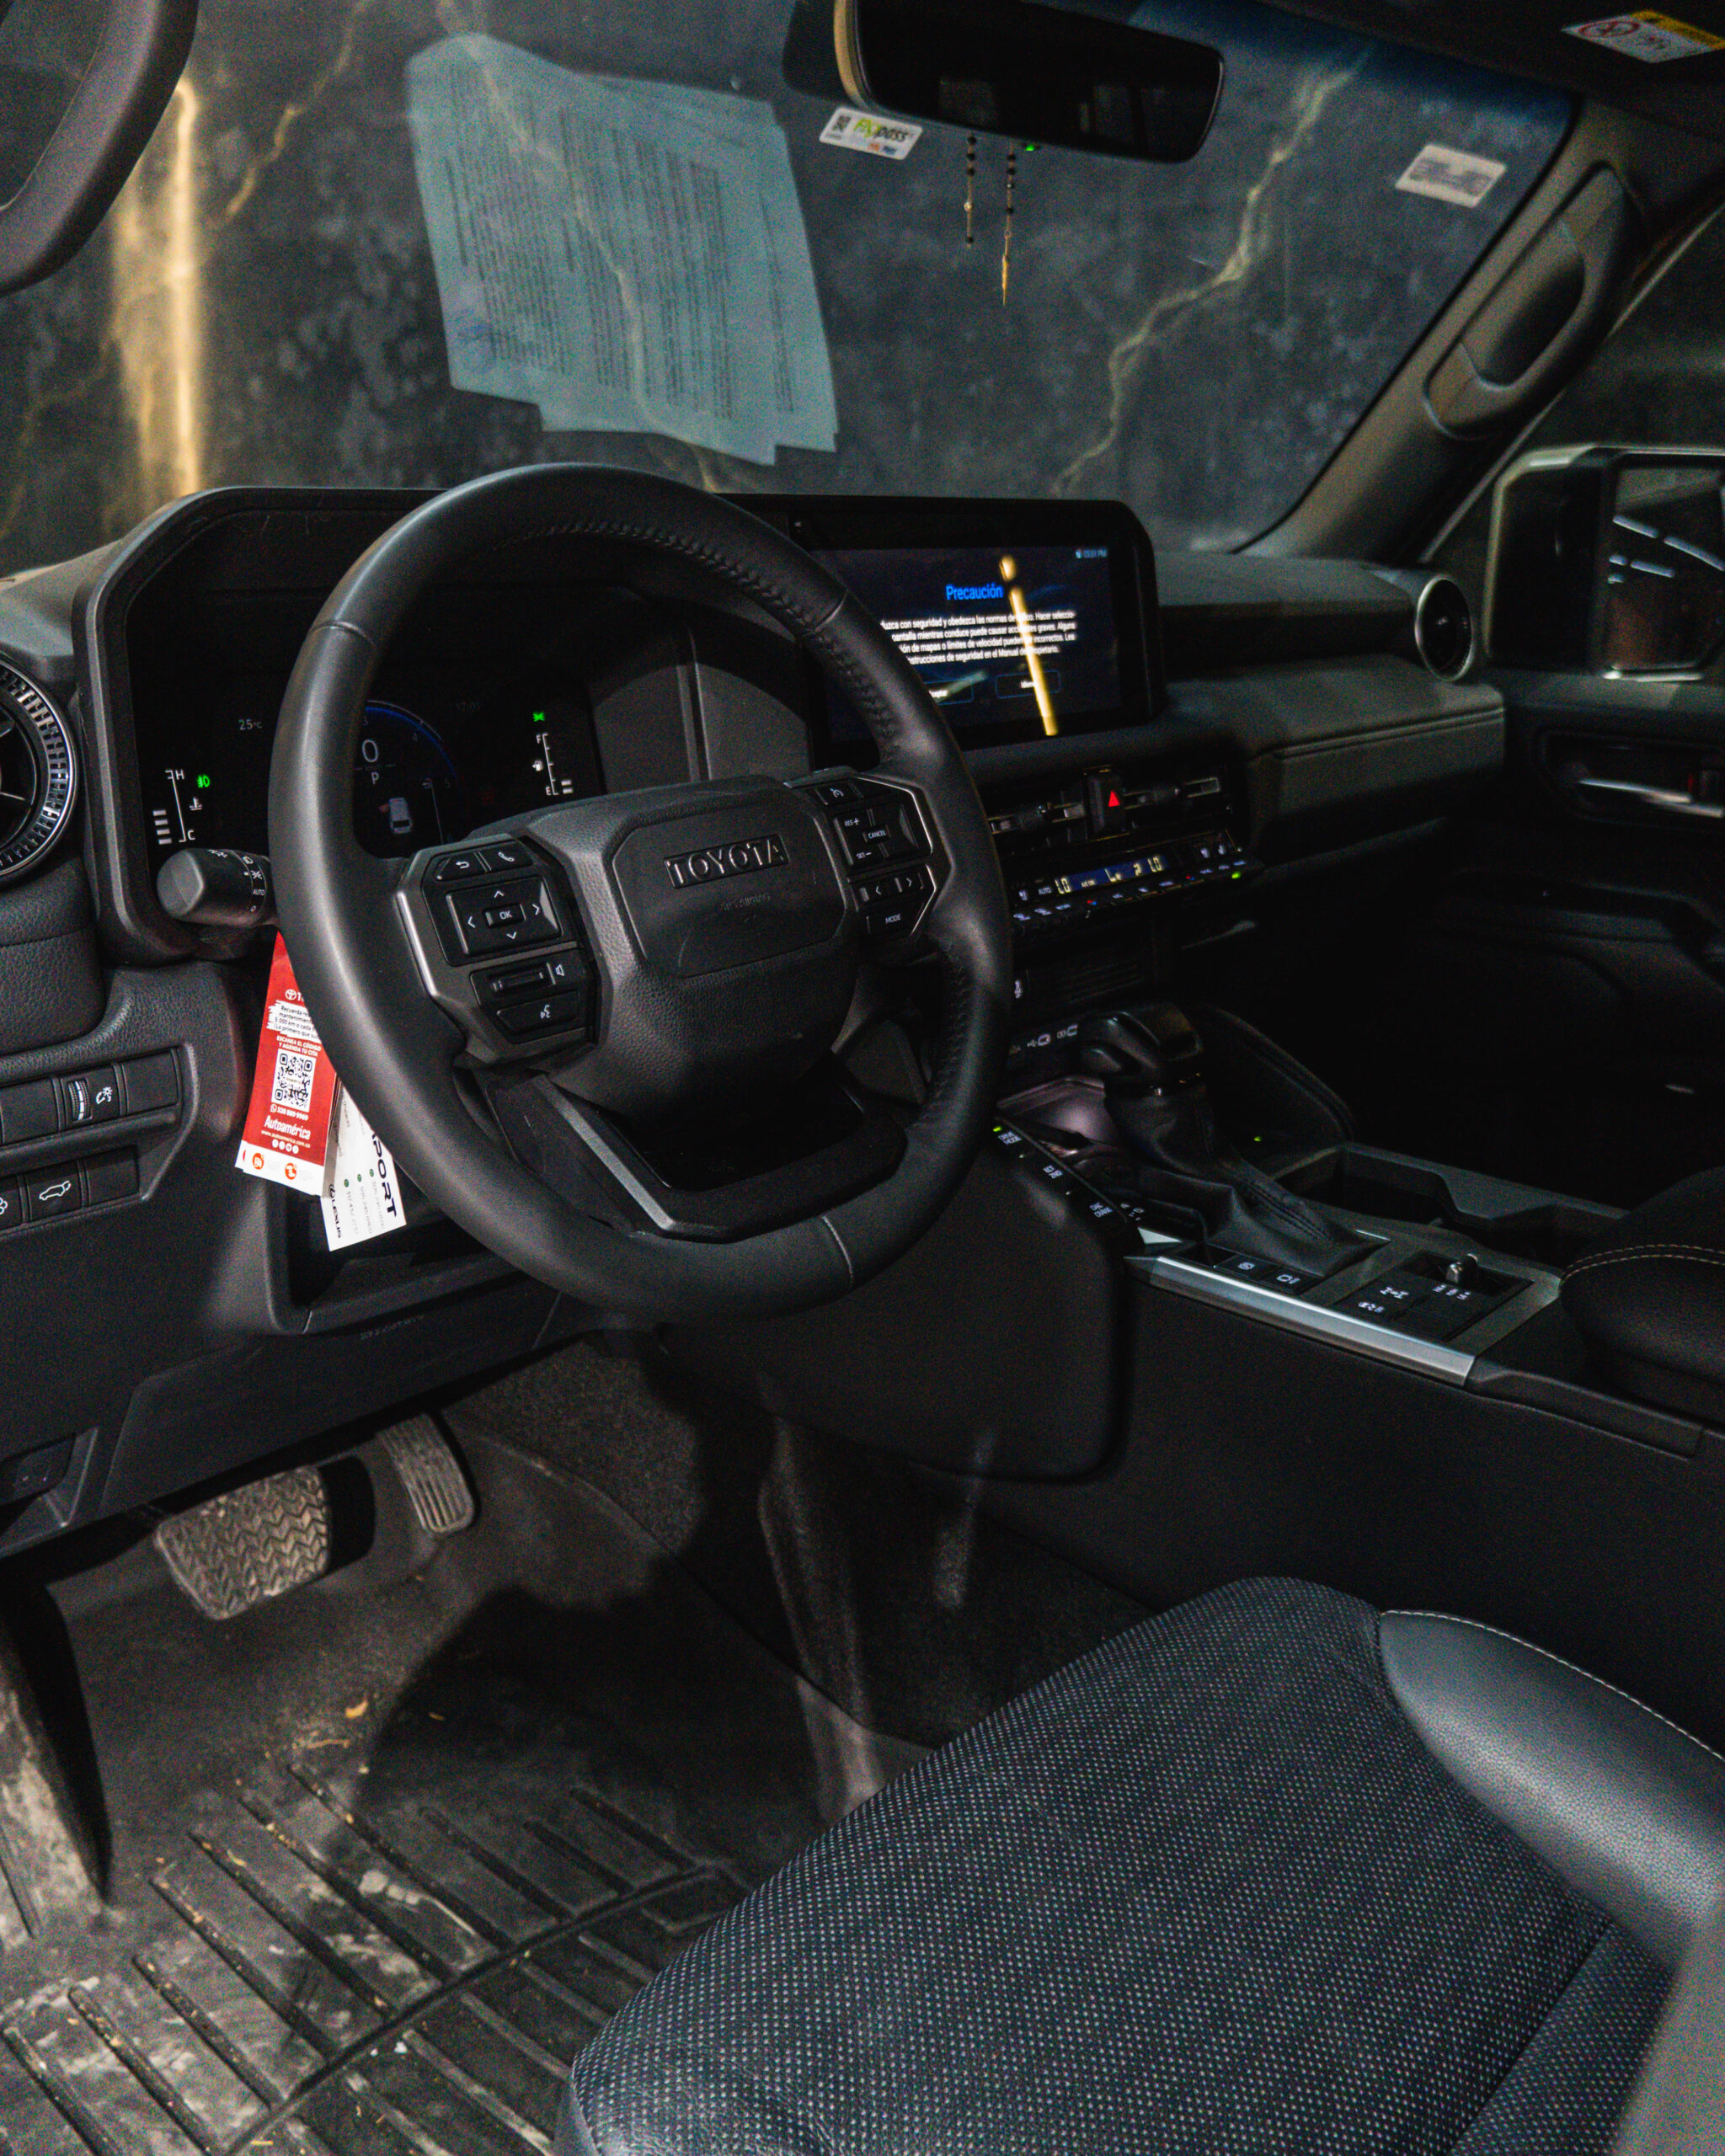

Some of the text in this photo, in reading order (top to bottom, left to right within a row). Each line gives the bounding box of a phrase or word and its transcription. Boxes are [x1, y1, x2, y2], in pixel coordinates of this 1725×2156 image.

[946, 582, 1003, 600] Precaución
[900, 619, 911, 629] con
[912, 616, 943, 630] seguridad
[948, 616, 975, 626] obedezca
[976, 615, 985, 624] las
[985, 615, 1007, 624] normas
[1008, 614, 1015, 622] de
[917, 631, 943, 639] mientras
[944, 628, 969, 638] conduce
[969, 627, 987, 638] puede
[988, 627, 1007, 635] causar
[911, 643, 920, 653] de
[921, 643, 941, 653] mapas
[967, 639, 975, 648] de
[976, 638, 1002, 648] velocidad
[947, 653, 954, 661] de
[955, 651, 983, 662] seguridad
[998, 648, 1018, 657] Manual
[536, 734, 542, 744] F
[361, 738, 380, 763] 0
[175, 769, 185, 781] H
[371, 771, 380, 785] P
[546, 786, 552, 796] E
[187, 829, 195, 841] C
[868, 830, 887, 840] CANCEL
[666, 839, 784, 884] TOYOTA
[252, 888, 265, 896] AUTO
[1039, 887, 1051, 895] AUTO
[499, 910, 513, 920] OK
[885, 914, 901, 924] MODE
[276, 1035, 297, 1045] ESCANEA
[264, 1115, 312, 1140] Autoamérica
[331, 1198, 342, 1238] LEXUS
